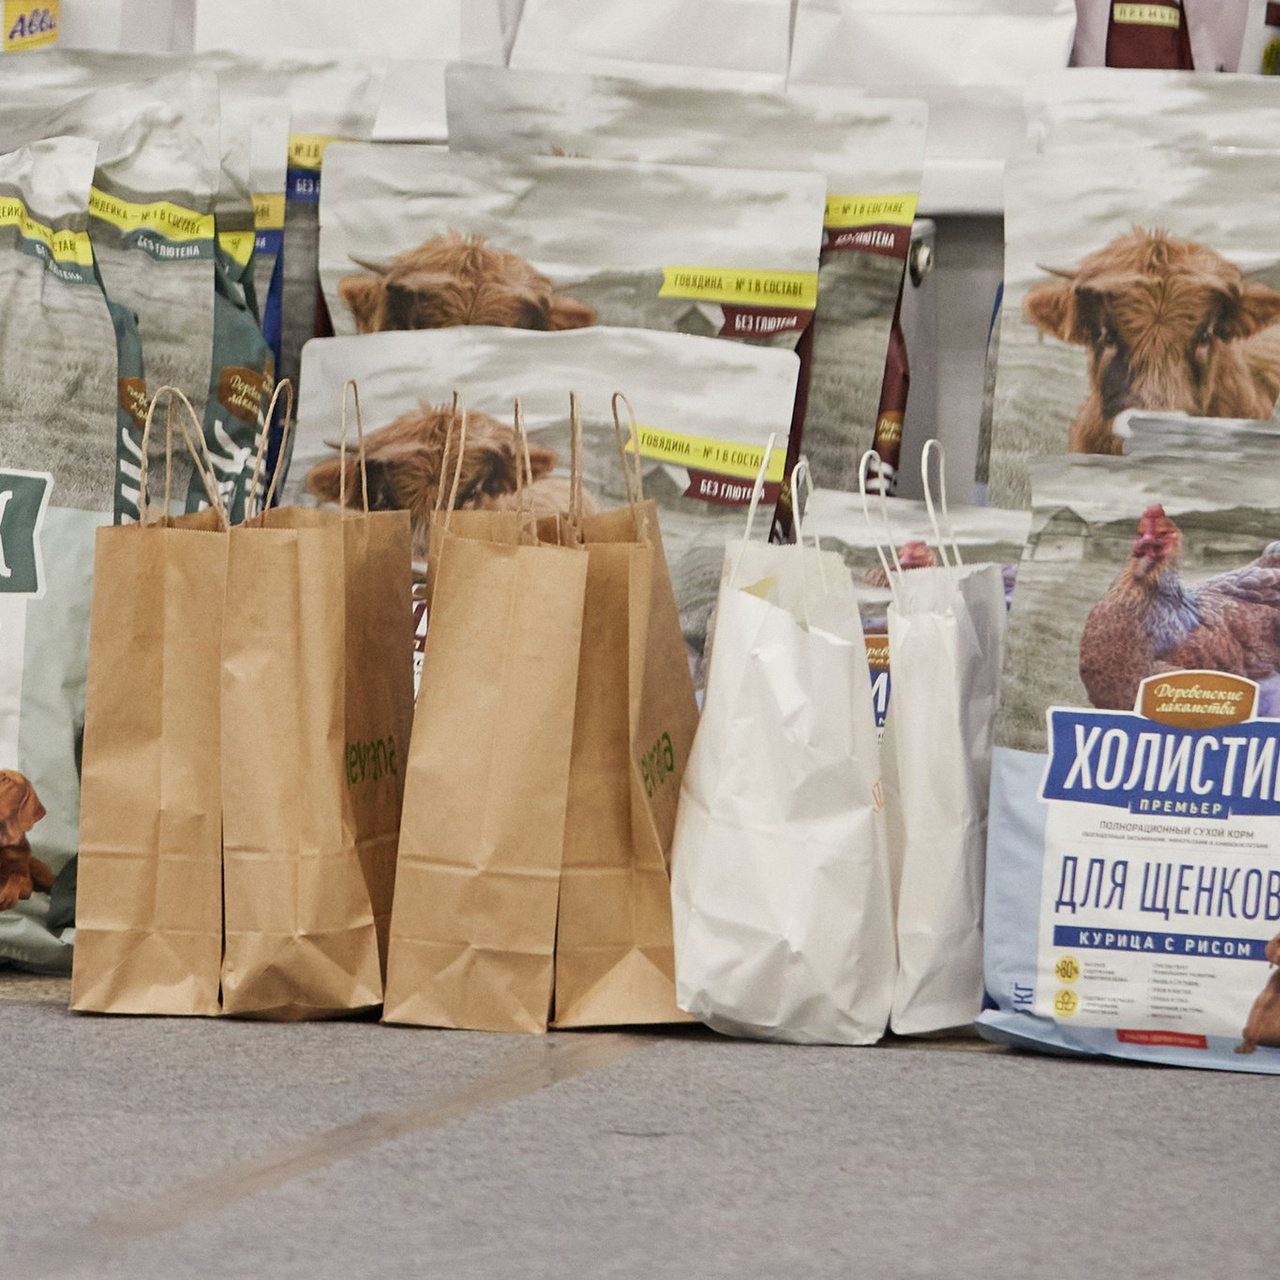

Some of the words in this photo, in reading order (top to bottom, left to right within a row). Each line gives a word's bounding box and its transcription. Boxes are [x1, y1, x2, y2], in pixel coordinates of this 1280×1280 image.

[866, 202, 903, 214] СОСТАВЕ
[674, 273, 723, 290] ГОВЯДИНА
[763, 280, 803, 296] СОСТАВЕ
[735, 314, 754, 332] БЕЗ
[755, 315, 797, 331] ГЛЮТЕНА
[641, 432, 691, 455] ГОВЯДИНА
[700, 478, 718, 497] БЕЗ
[720, 484, 766, 502] ГЛЮТЕА
[1139, 798, 1223, 815] ПРЕМЬЕР
[1193, 826, 1225, 838] СУХОЙ
[1227, 828, 1255, 839] КОРМ
[1054, 855, 1129, 914] ДЛЯ
[1139, 862, 1280, 921] ЩЕНКОВ
[1079, 930, 1154, 950] КУРИЦА
[1164, 939, 1174, 950] С
[1185, 941, 1252, 956] РИСОМ
